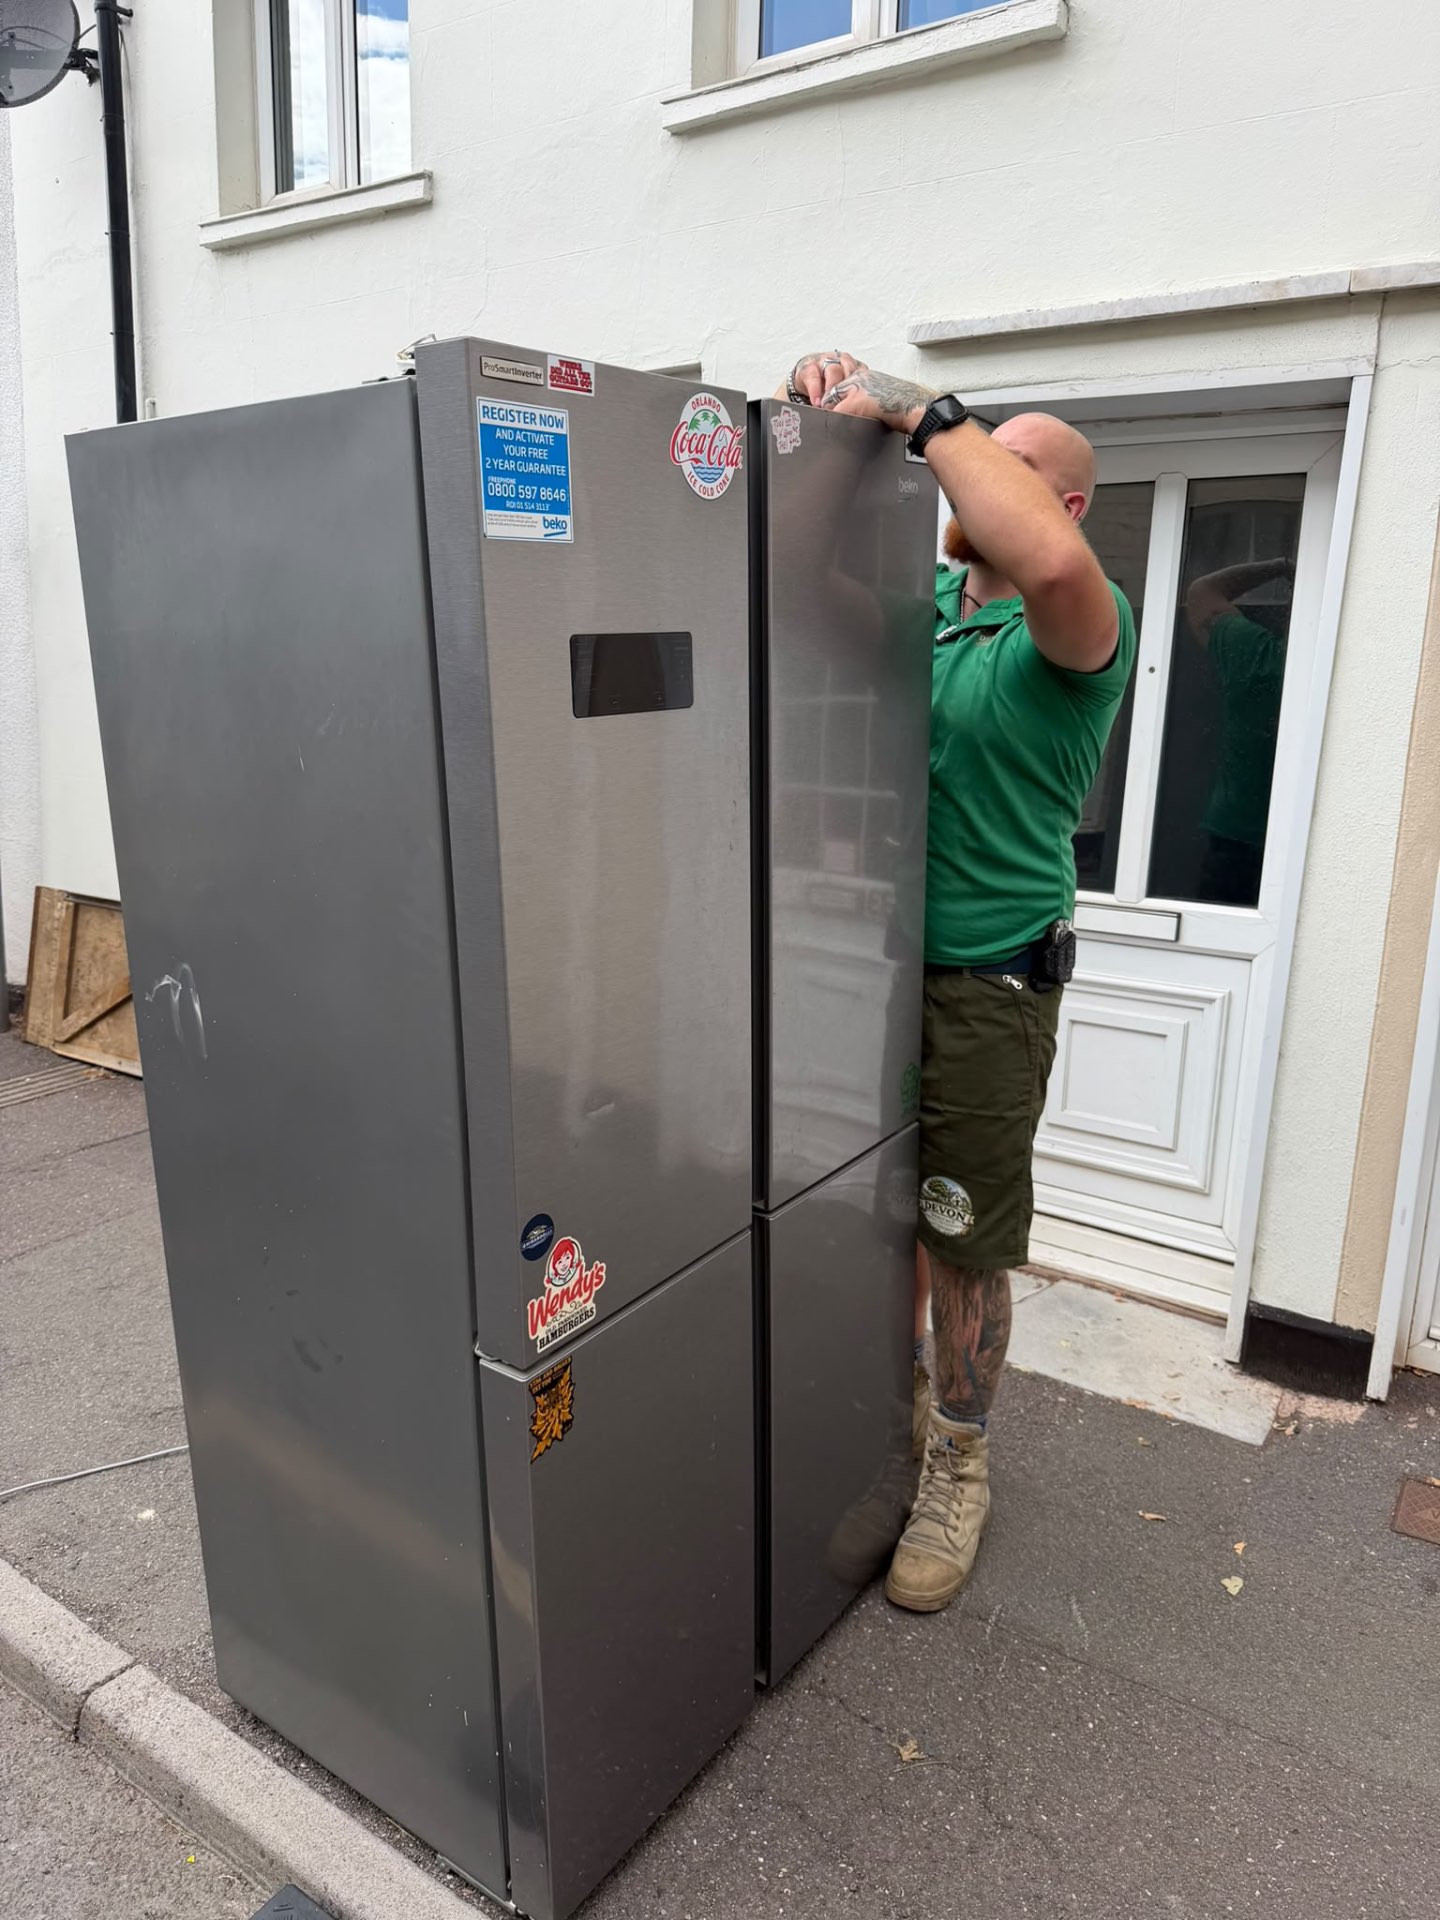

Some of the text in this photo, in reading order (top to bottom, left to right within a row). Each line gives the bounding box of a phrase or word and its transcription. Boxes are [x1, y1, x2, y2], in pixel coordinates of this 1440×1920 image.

[483, 361, 542, 380] ProSmartInverter
[691, 396, 721, 413] ORLANDO
[482, 405, 565, 430] REGISTER NOW
[495, 428, 555, 446] AND ACTIVATE
[503, 444, 549, 460] YOUR FREE
[485, 457, 567, 476] 2 YEAR GUARANTEE
[487, 482, 567, 502] 0800 597 8646
[687, 471, 698, 488] ICE
[699, 484, 715, 497] COLD
[543, 516, 568, 531] beko
[925, 1200, 966, 1221] DEVON
[529, 1263, 604, 1338] Wendy's
[539, 1306, 595, 1349] HAMBURGERS
